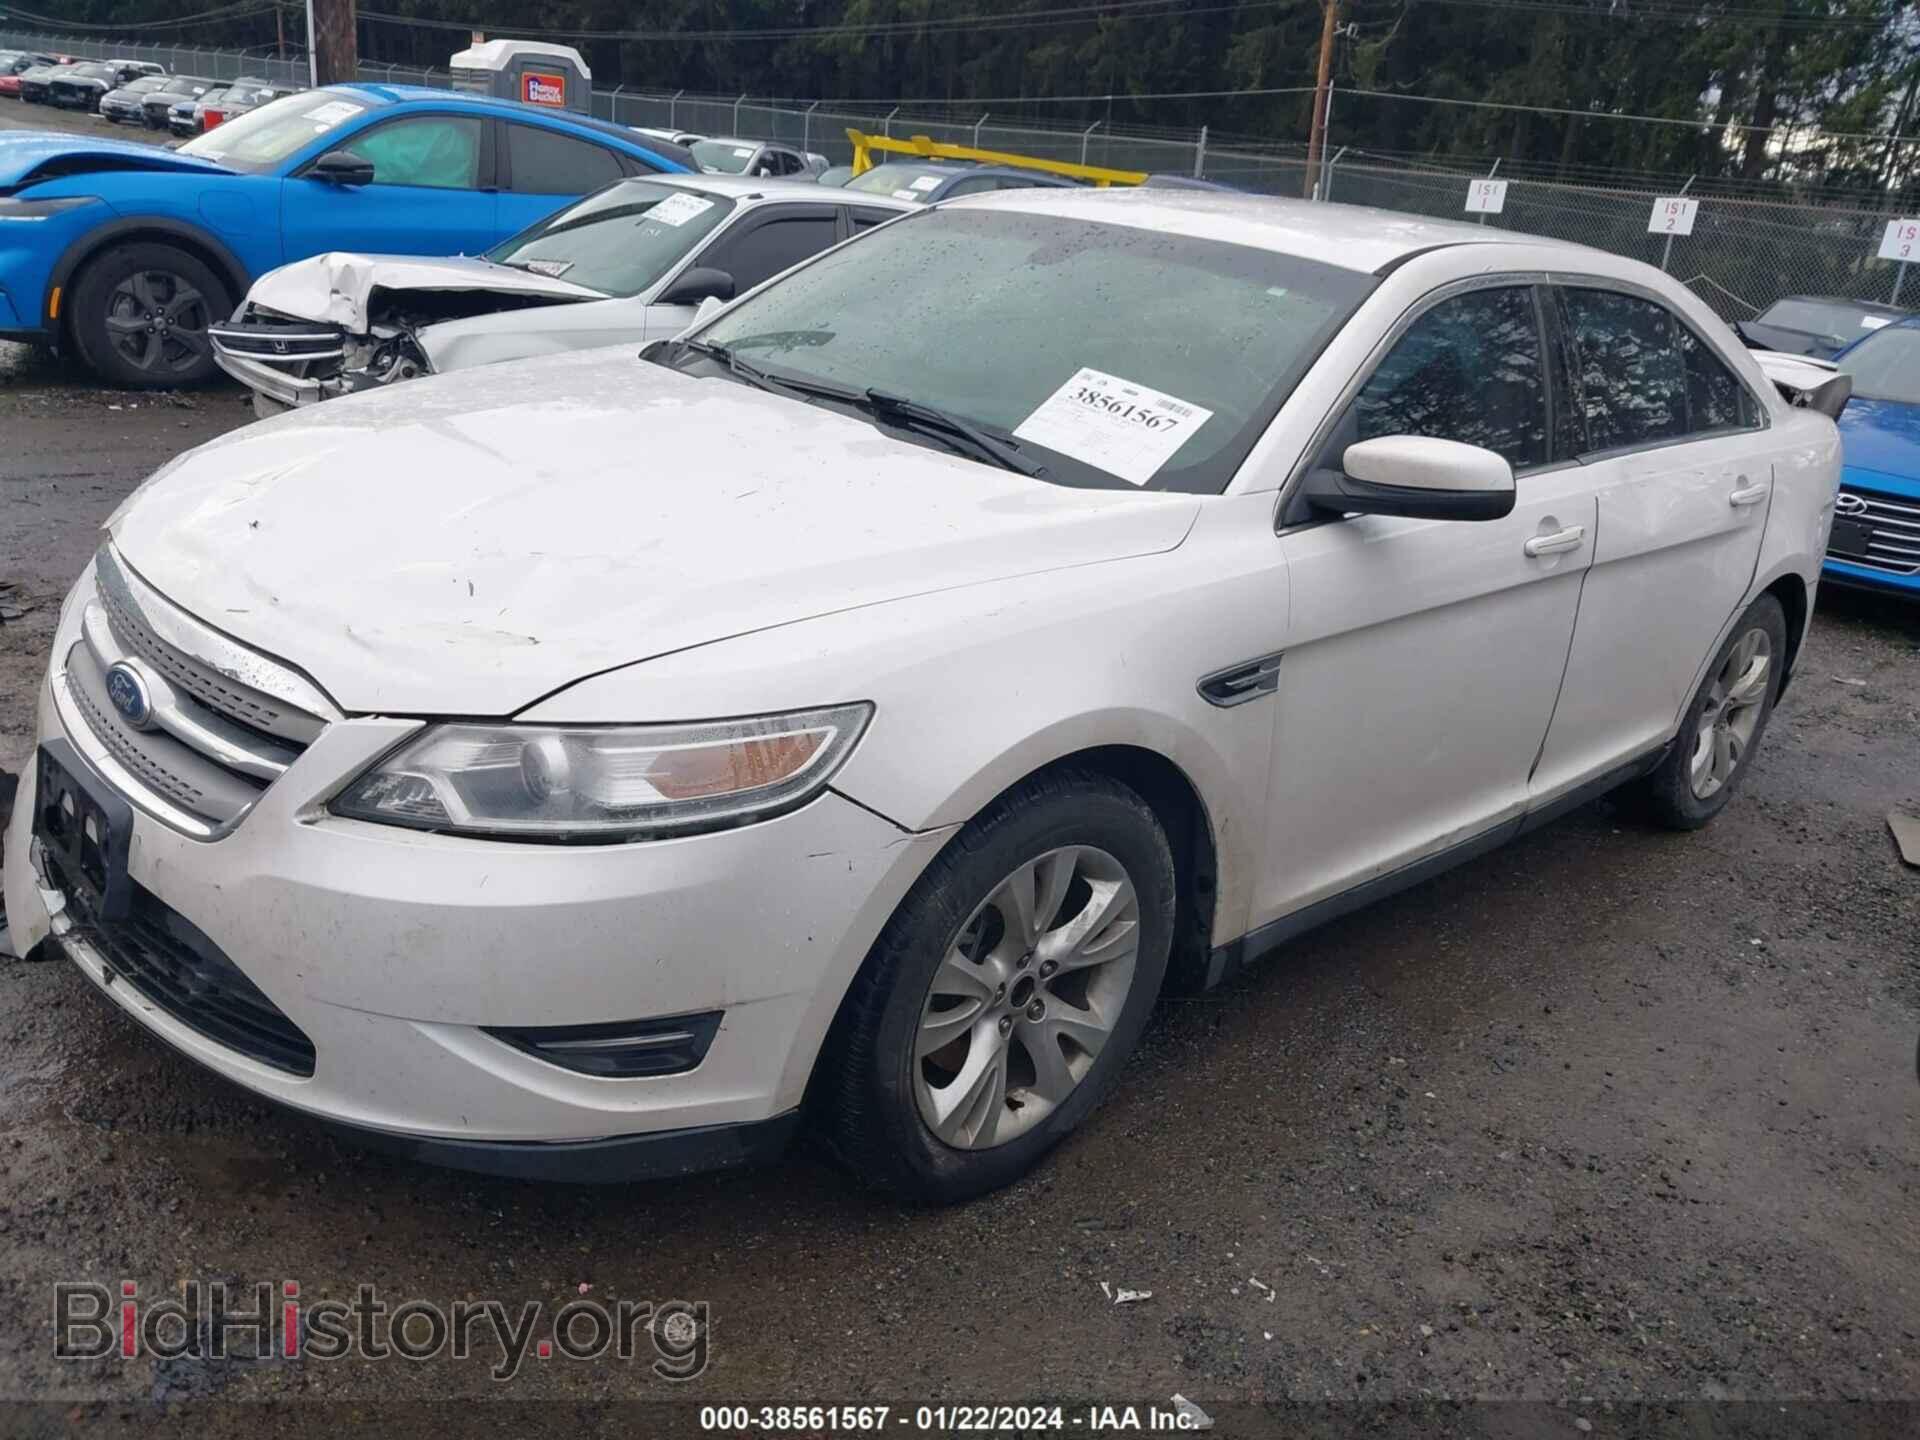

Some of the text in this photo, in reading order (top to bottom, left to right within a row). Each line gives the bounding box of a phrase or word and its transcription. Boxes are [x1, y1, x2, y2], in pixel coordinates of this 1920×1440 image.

[1665, 218, 1676, 230] 2
[1900, 244, 1911, 257] 3
[1068, 386, 1179, 433] 38561567
[111, 673, 136, 713] Ford
